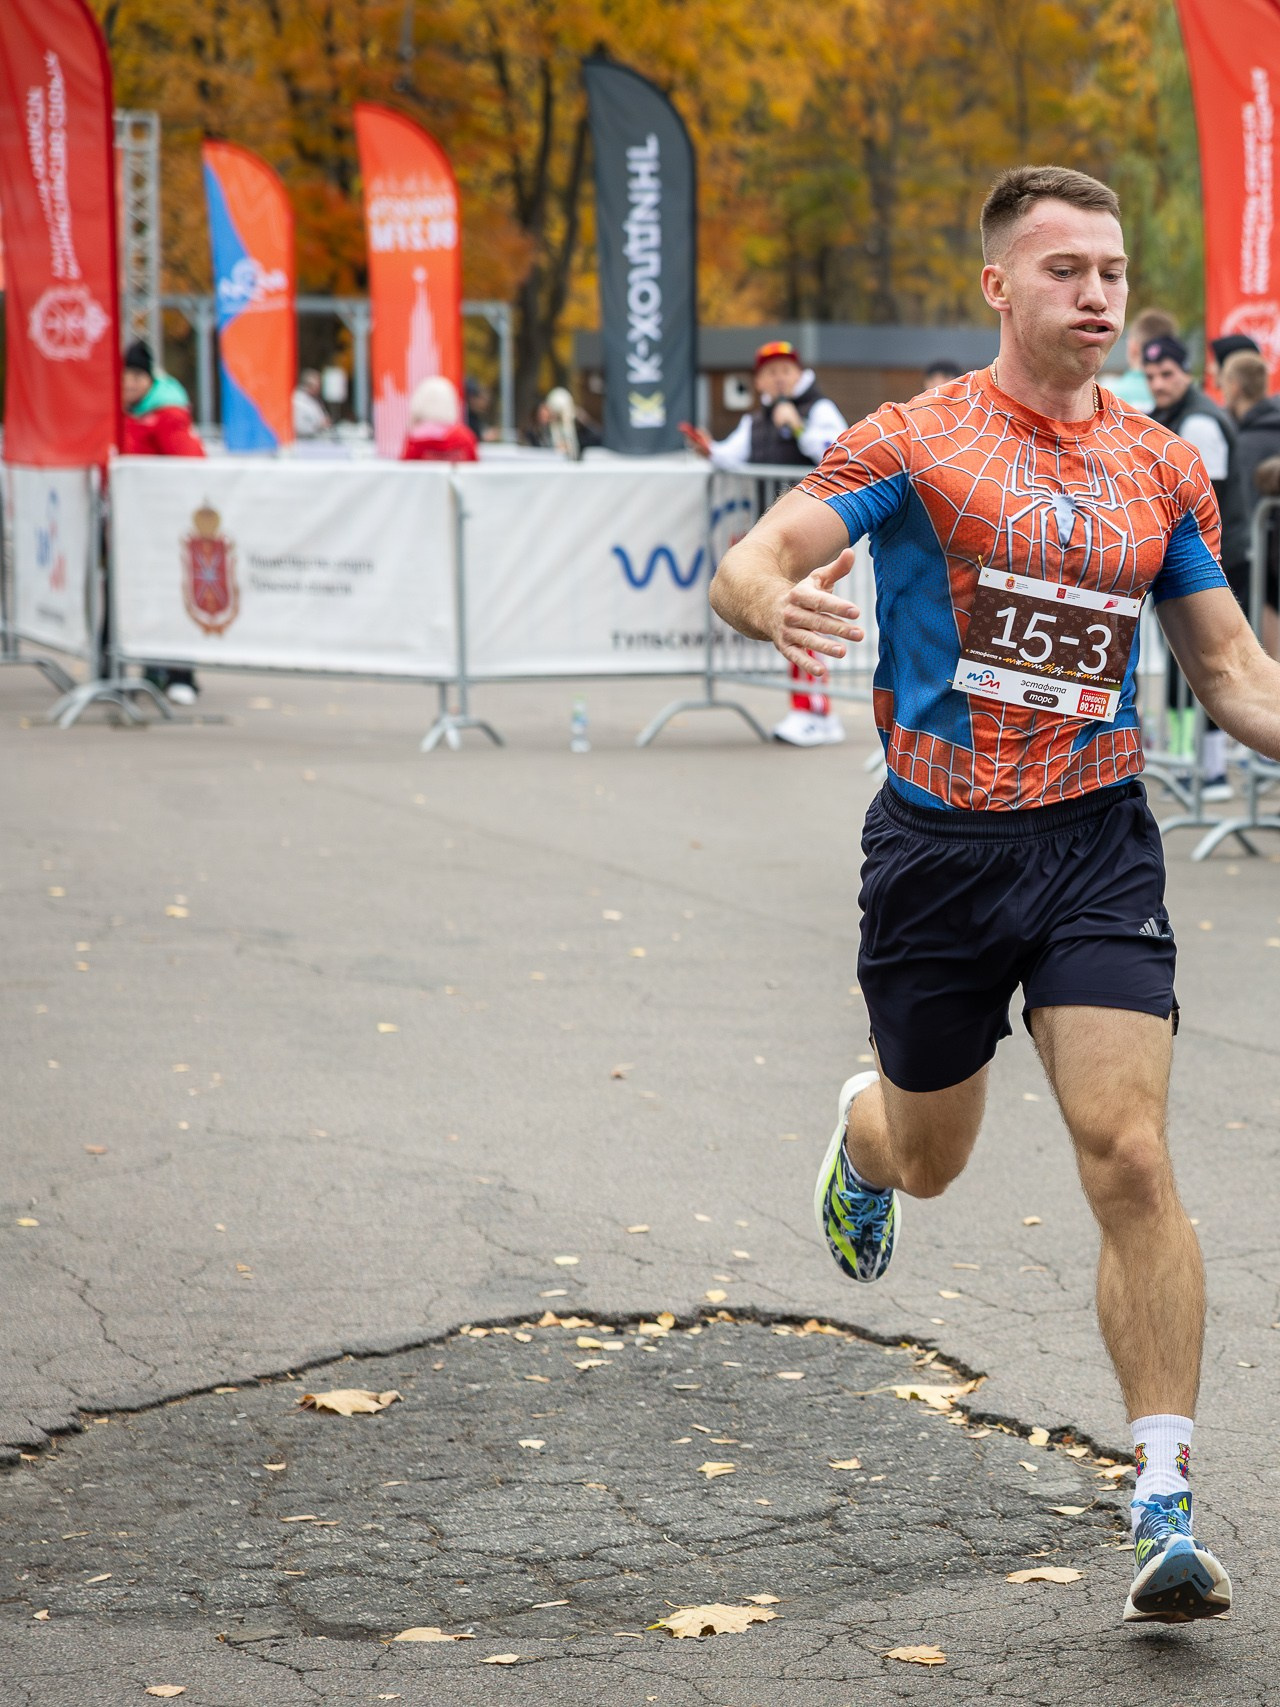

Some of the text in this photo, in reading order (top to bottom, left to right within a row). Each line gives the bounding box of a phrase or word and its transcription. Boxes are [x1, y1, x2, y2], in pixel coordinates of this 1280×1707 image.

[991, 606, 1112, 674] 15-3
[1020, 679, 1067, 694] эстафета
[1081, 695, 1107, 705] ГОРДОСТЬ
